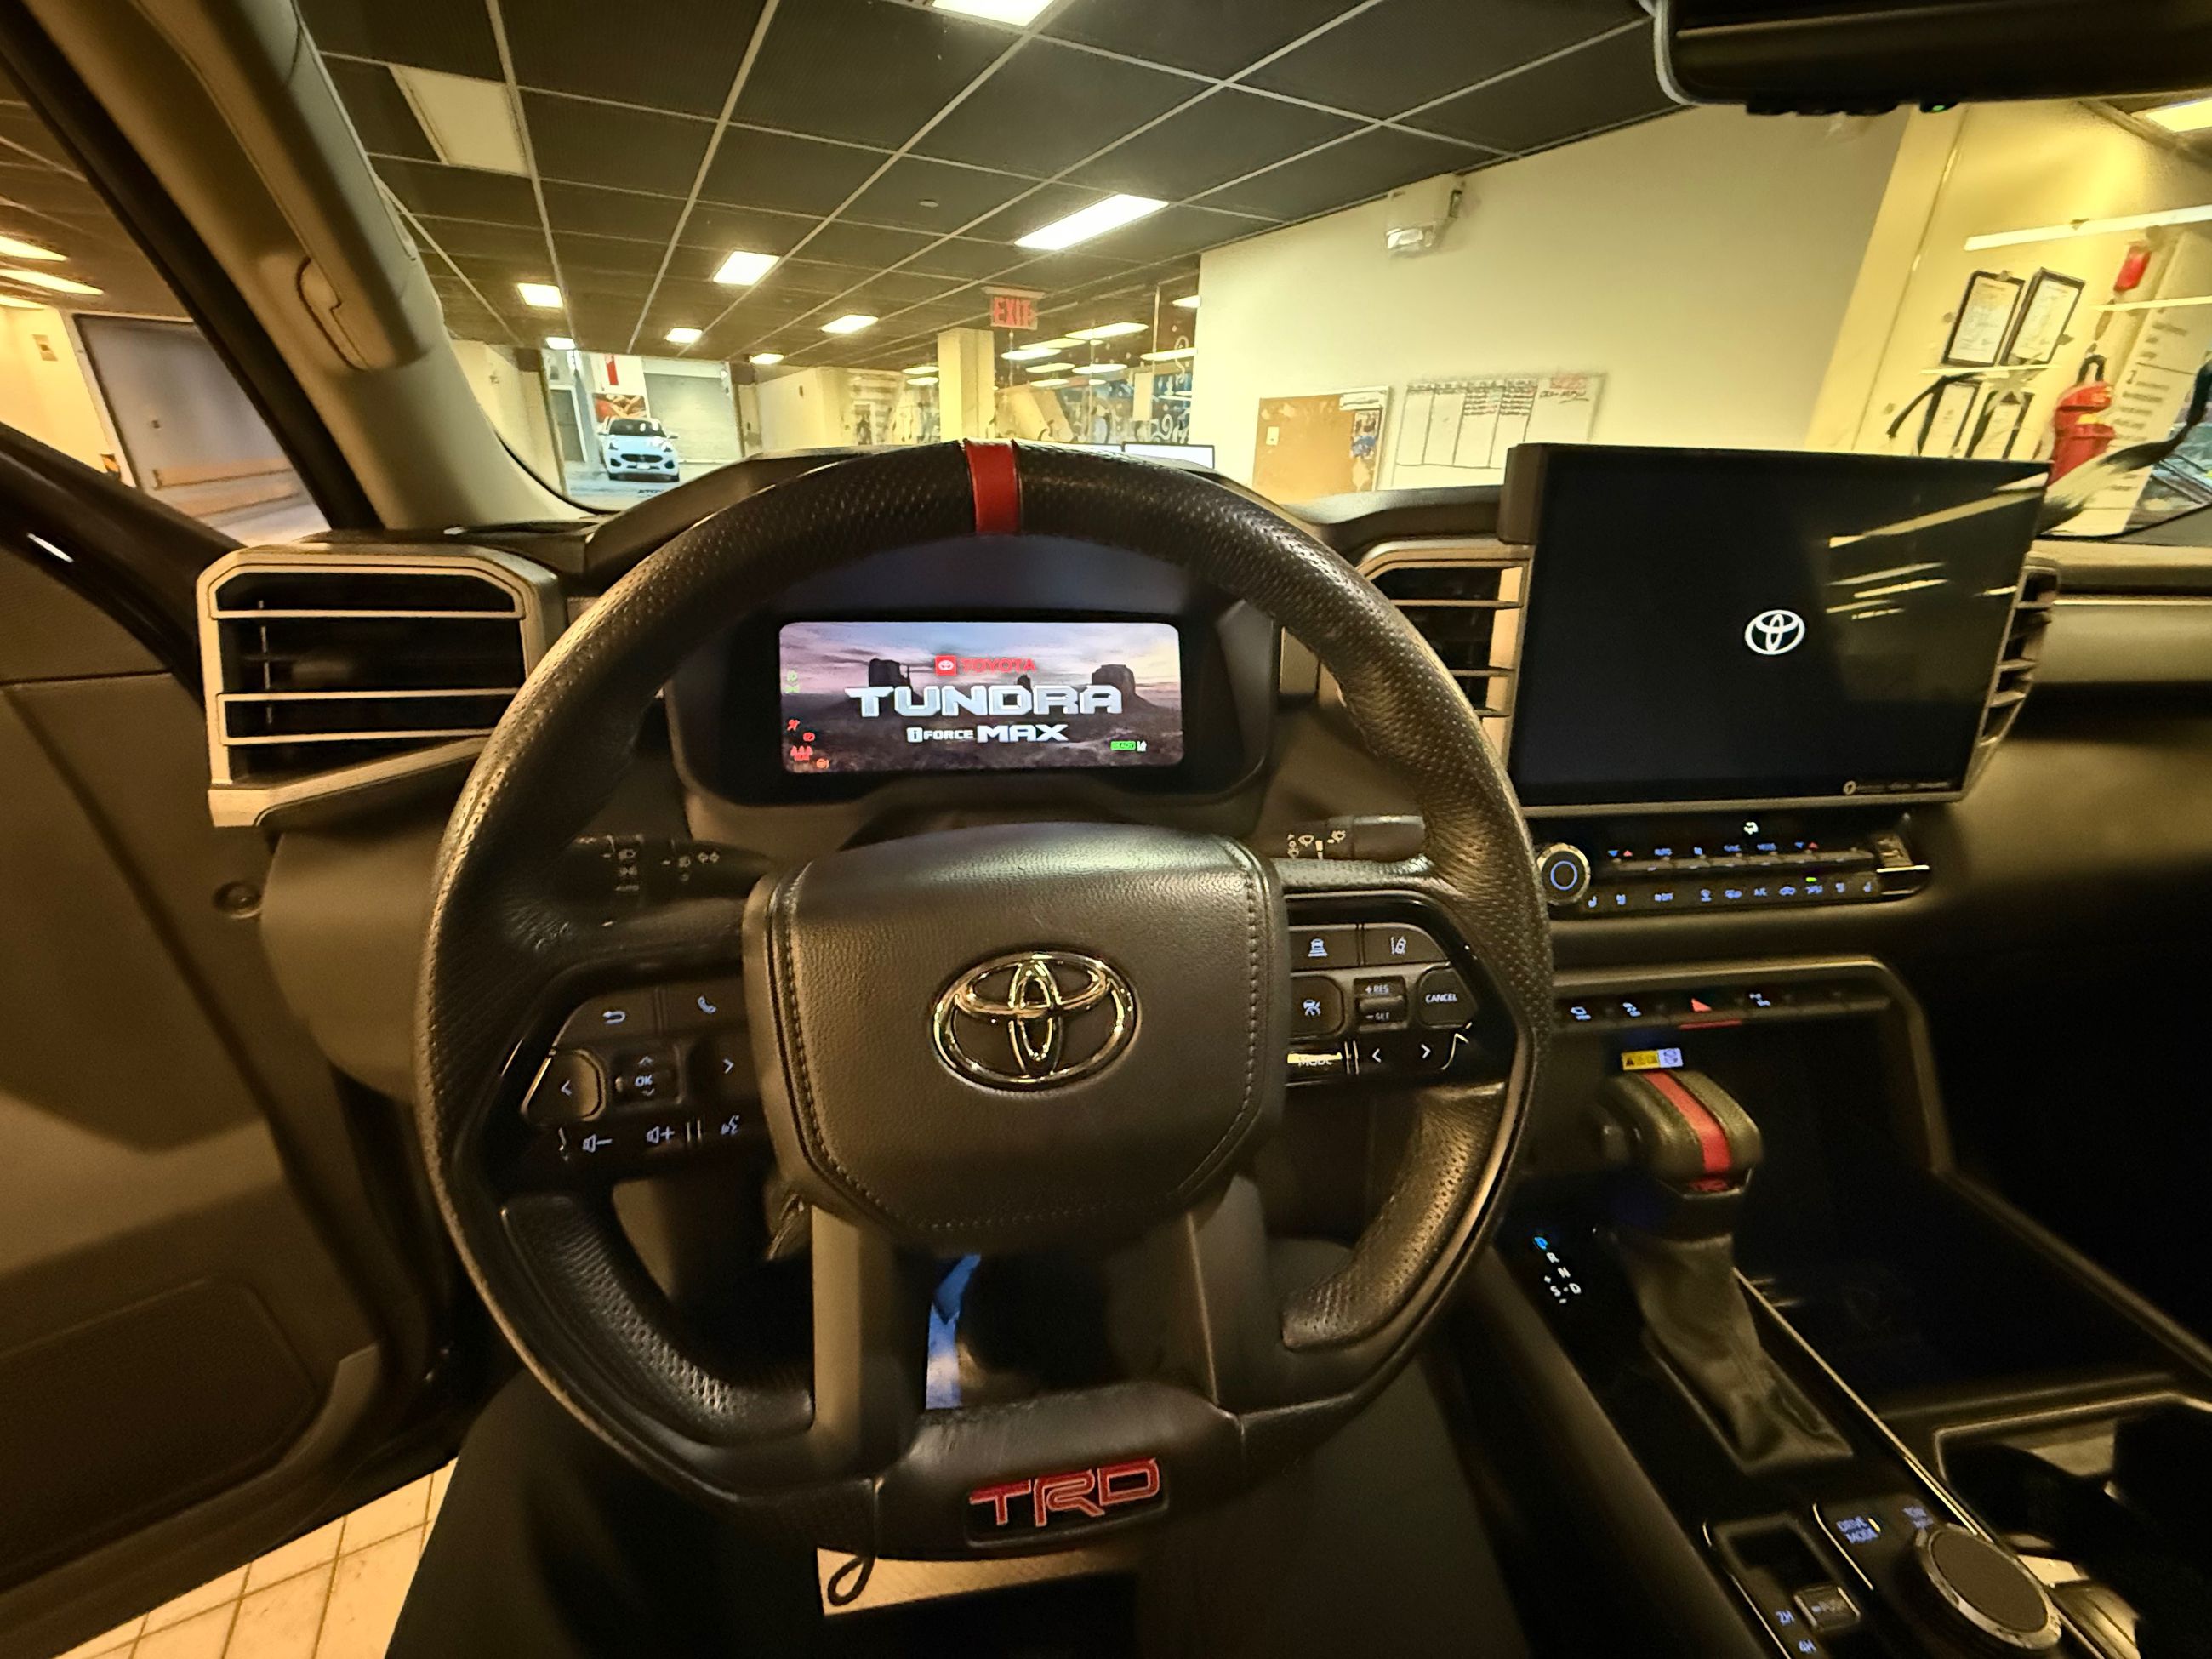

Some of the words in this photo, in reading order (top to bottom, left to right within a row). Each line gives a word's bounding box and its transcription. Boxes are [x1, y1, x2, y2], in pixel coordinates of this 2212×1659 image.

[994, 298, 1030, 327] EXIT
[961, 658, 1035, 672] TOYOTA
[845, 686, 1122, 717] TUNDRA
[977, 724, 1069, 743] MAX
[1425, 993, 1457, 1004] CANCEL
[635, 1075, 653, 1086] OK
[1546, 1251, 1559, 1263] R
[1550, 1285, 1561, 1297] S
[1569, 1282, 1582, 1294] D
[969, 1457, 1160, 1527] TRD
[1776, 1610, 1794, 1626] 2H
[1799, 1639, 1816, 1654] 4H
